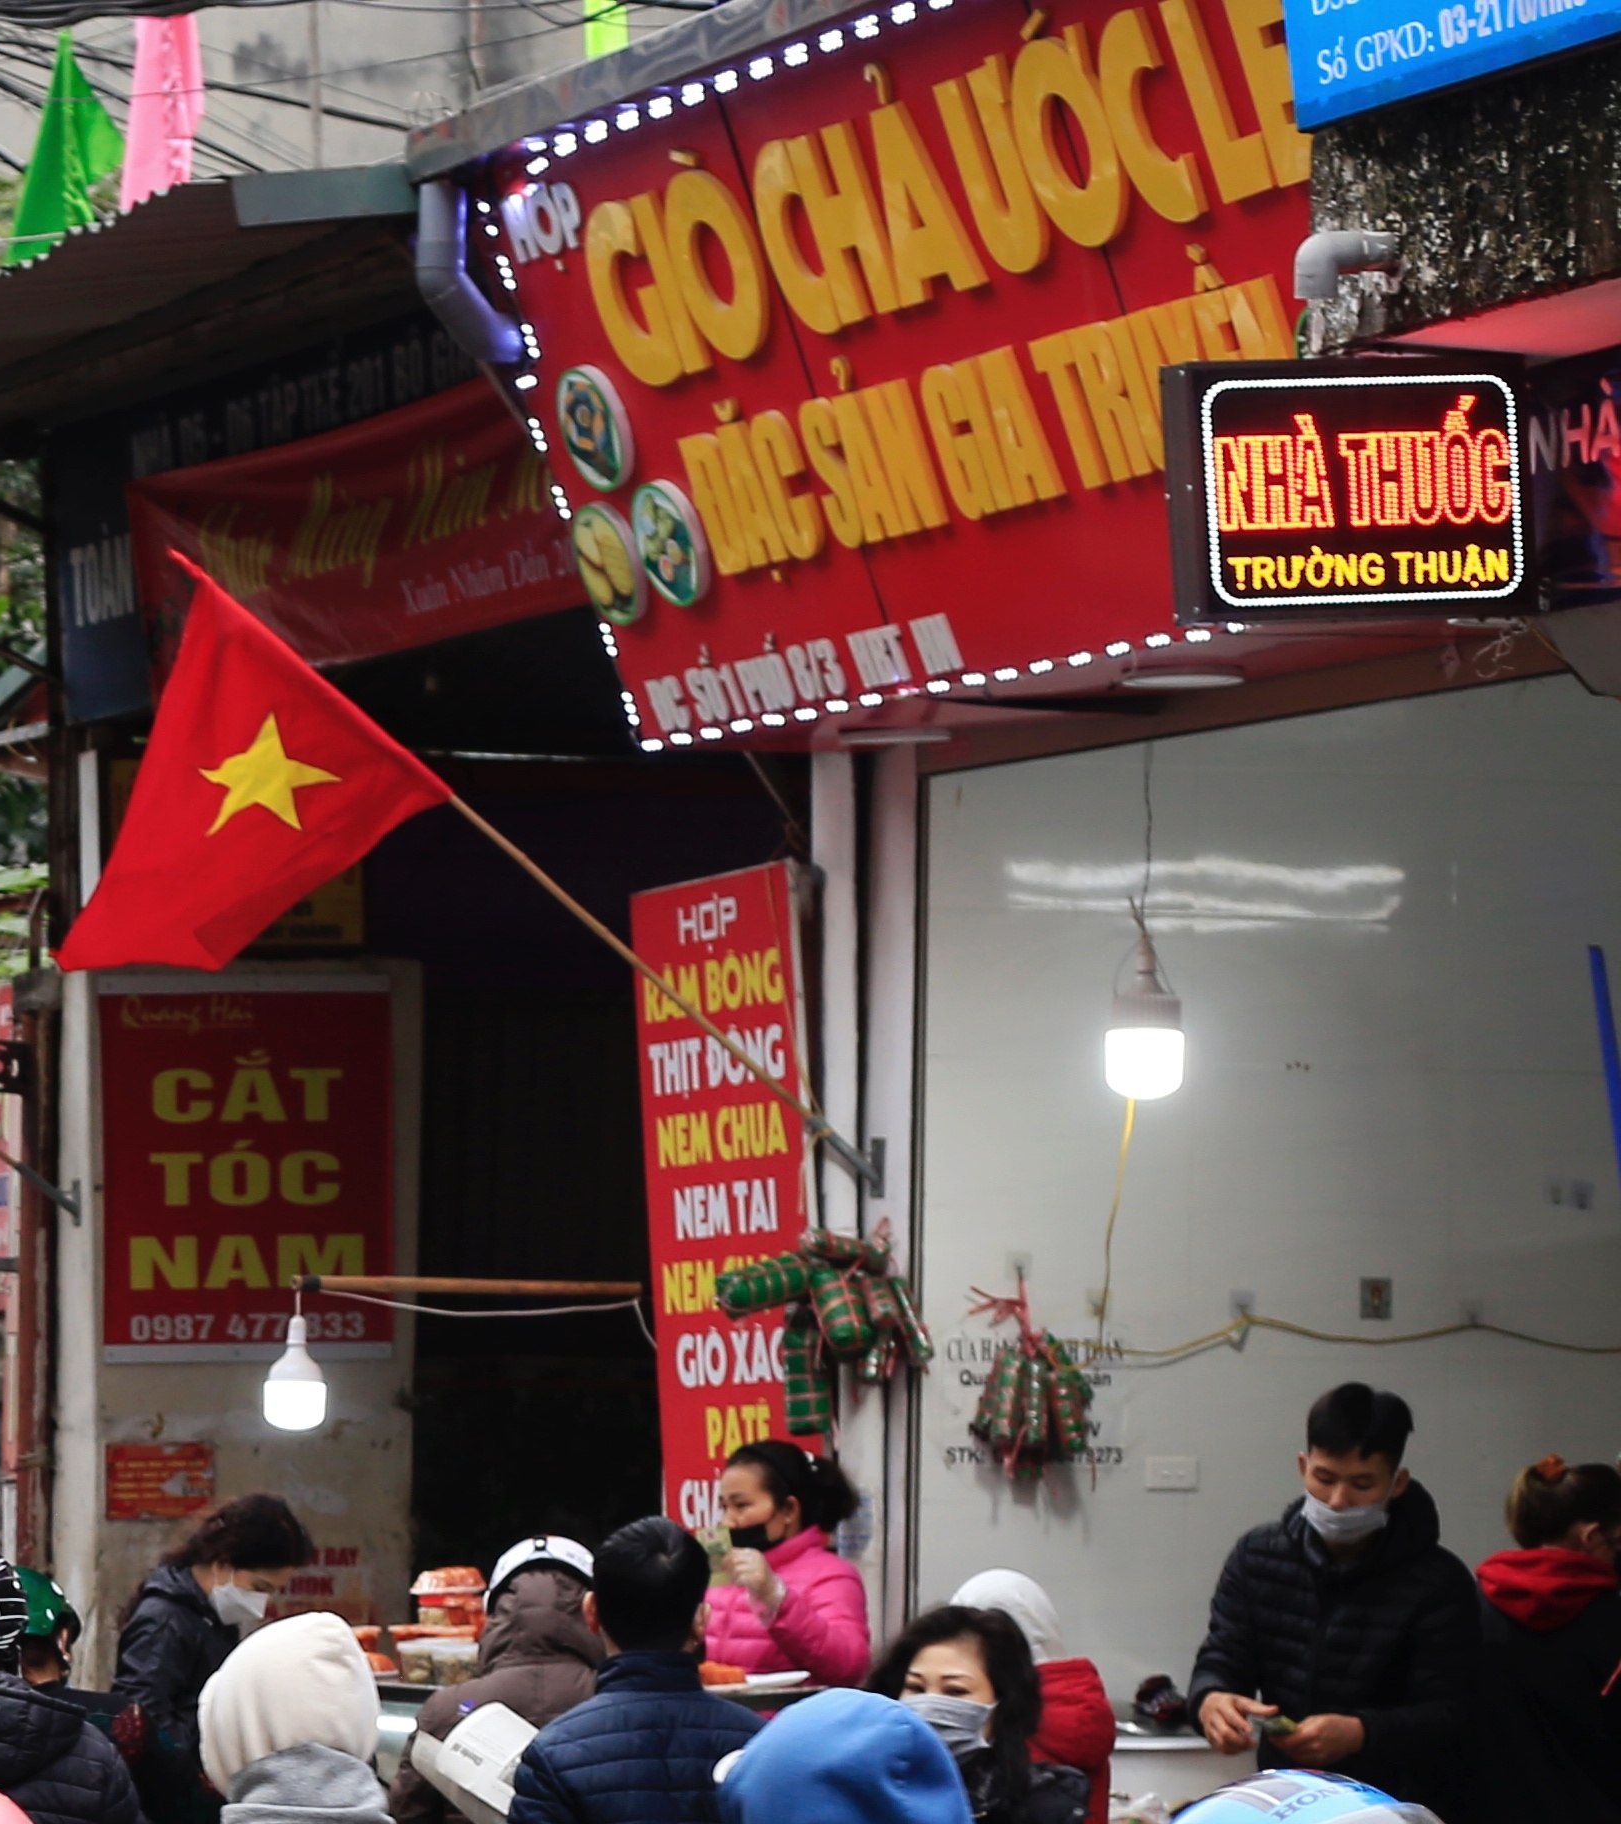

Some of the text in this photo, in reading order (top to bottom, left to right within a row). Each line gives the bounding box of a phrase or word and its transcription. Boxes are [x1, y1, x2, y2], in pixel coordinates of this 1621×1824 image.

[1355, 21, 1436, 71] GPKD:
[585, 148, 769, 387] GIÒ
[756, 63, 988, 334] CHẢ
[934, 6, 1209, 273] ƯỚC
[798, 355, 949, 549] SẢN
[919, 345, 1067, 520] GIA
[1213, 393, 1512, 531] NHÀ THUỐC
[1392, 544, 1510, 589] THUẬN
[151, 1048, 344, 1123] CẮT
[647, 1036, 702, 1099] THỊT
[656, 1100, 789, 1169] NEM CHUA
[148, 1138, 342, 1207] TÓC
[673, 1177, 780, 1240] NEM TAI
[129, 1233, 366, 1291] NAM
[661, 1258, 719, 1316] NEM
[130, 1313, 215, 1341] 0987
[676, 1324, 728, 1389] GIÒ
